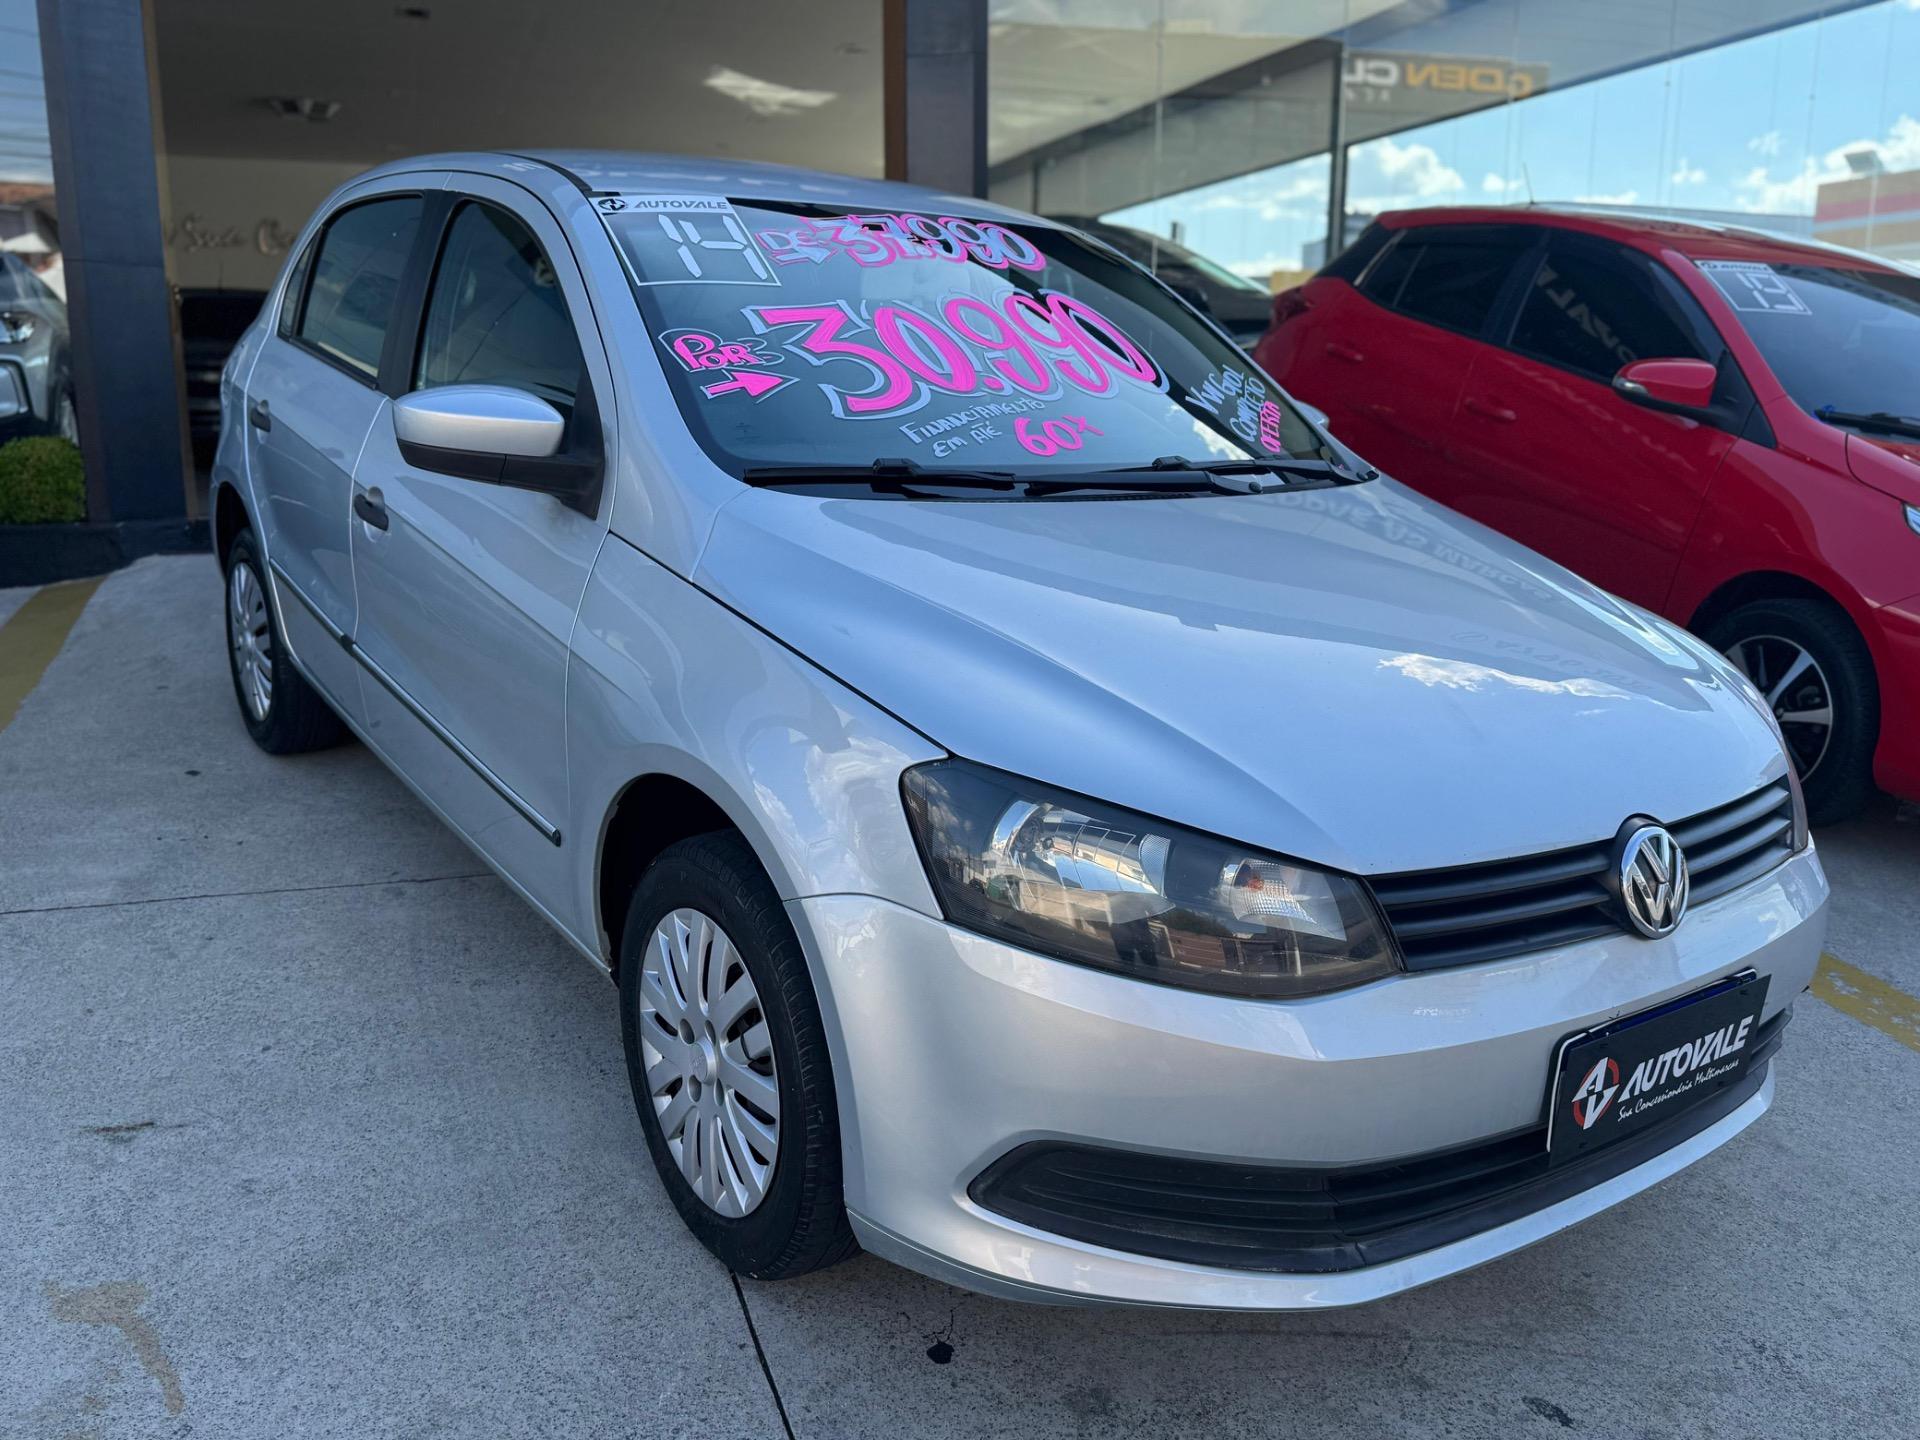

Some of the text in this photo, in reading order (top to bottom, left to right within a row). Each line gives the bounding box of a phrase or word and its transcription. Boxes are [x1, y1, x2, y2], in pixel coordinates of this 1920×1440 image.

[634, 200, 728, 210] AUTOVALE
[658, 213, 769, 280] 14
[745, 290, 1165, 416] 30.990
[932, 437, 968, 458] EM
[1260, 400, 1281, 453] OFERTA
[1617, 1015, 1754, 1103] AUTOVALE
[1617, 1106, 1633, 1122] Sua
